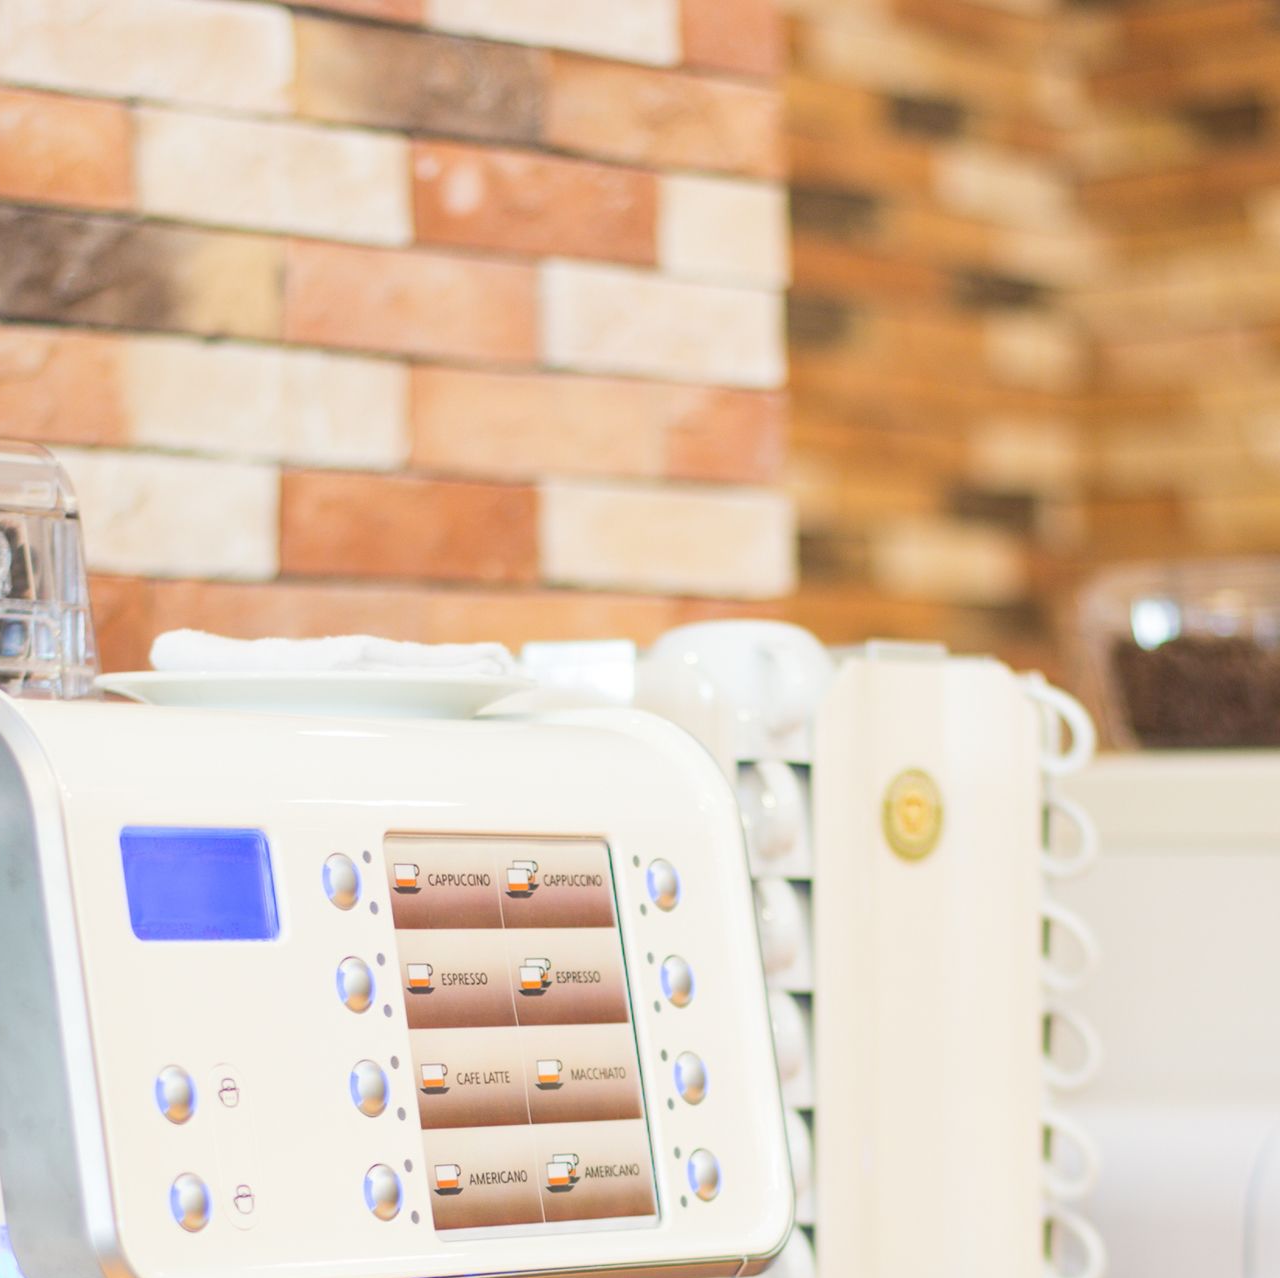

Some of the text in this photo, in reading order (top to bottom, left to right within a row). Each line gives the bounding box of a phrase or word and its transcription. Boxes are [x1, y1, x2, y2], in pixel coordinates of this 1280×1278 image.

[427, 873, 491, 887] CAPPUCCINO
[543, 873, 603, 887] CAPPUCCINO
[441, 972, 488, 986] ESPRESSO
[556, 970, 601, 984] ESPRESSO
[456, 1070, 511, 1085] CAFE LATTE
[570, 1066, 626, 1080] MACCHIATO
[469, 1170, 528, 1185] AMERICANO
[584, 1164, 640, 1179] AMERICANO
